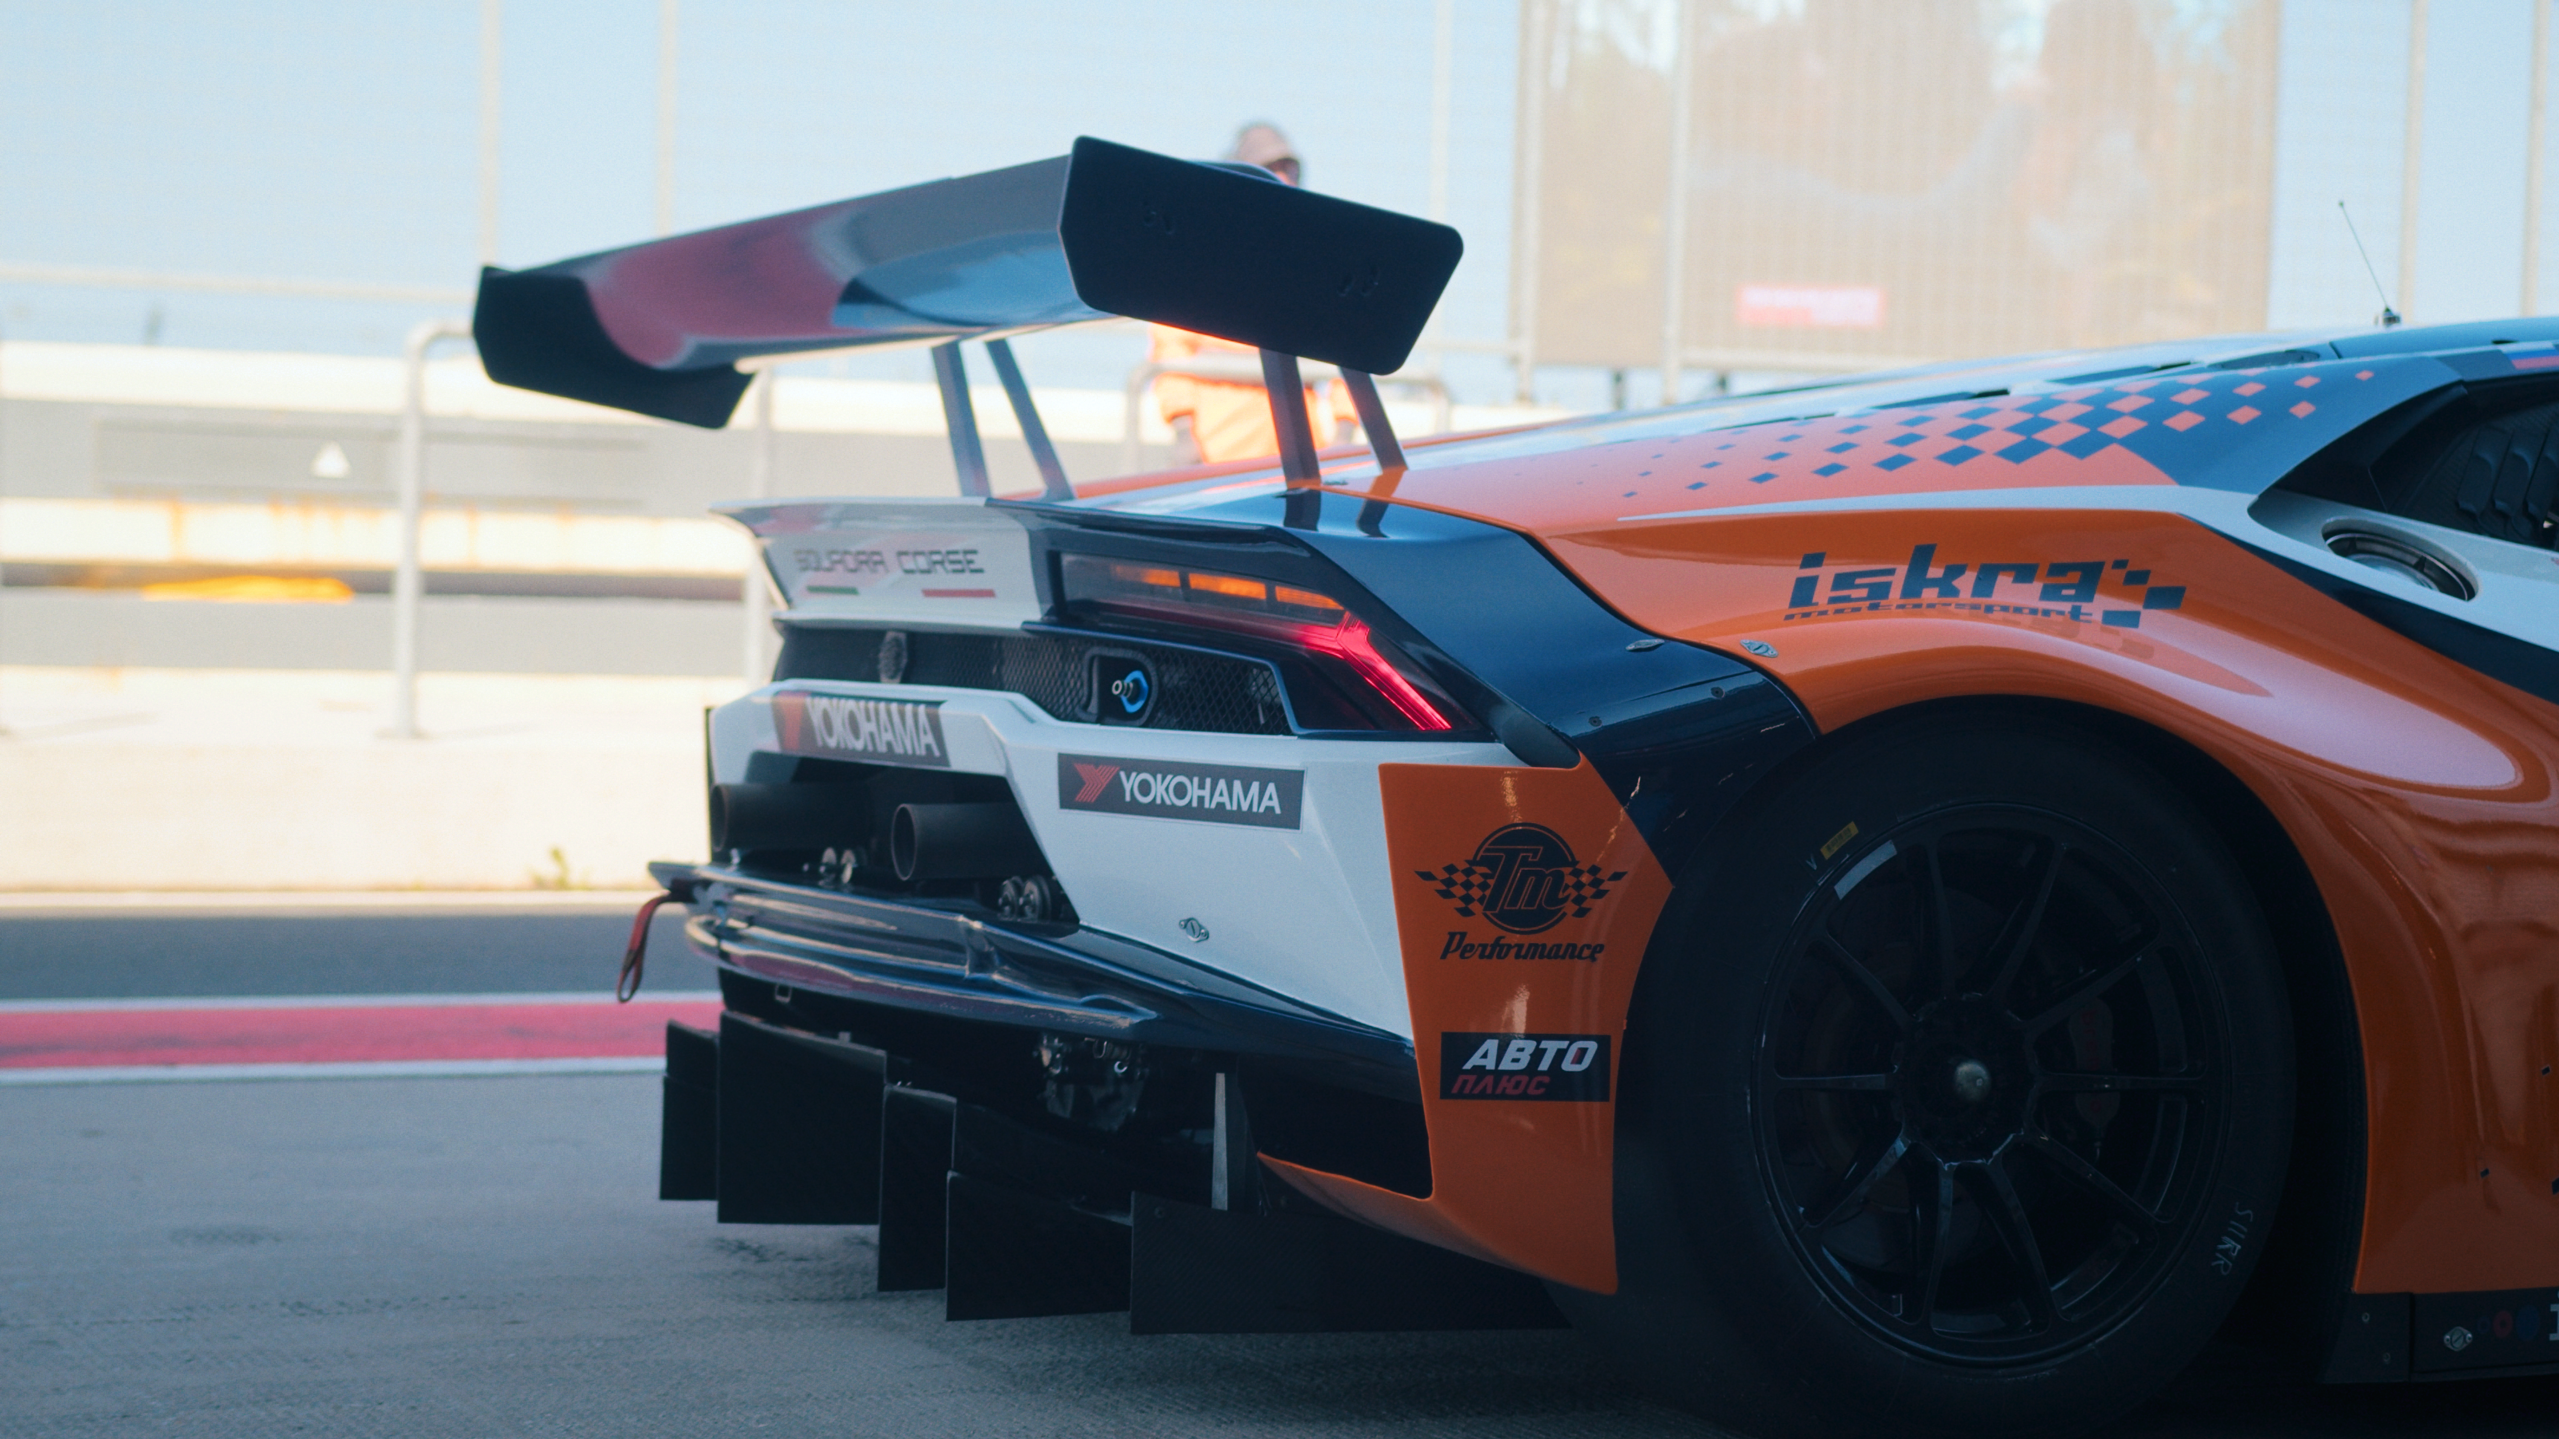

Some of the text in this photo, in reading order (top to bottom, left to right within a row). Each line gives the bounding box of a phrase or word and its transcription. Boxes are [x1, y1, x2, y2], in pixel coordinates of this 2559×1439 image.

[895, 549, 985, 574] CORSE
[1789, 543, 2106, 609] iskra
[1783, 602, 2093, 624] motorsport
[806, 696, 942, 759] YOKOHAMA
[1119, 770, 1282, 816] YOKOHAMA
[1440, 931, 1605, 963] Performance
[1462, 1039, 1599, 1072] АВТО
[1450, 1074, 1550, 1095] ПЛЮС
